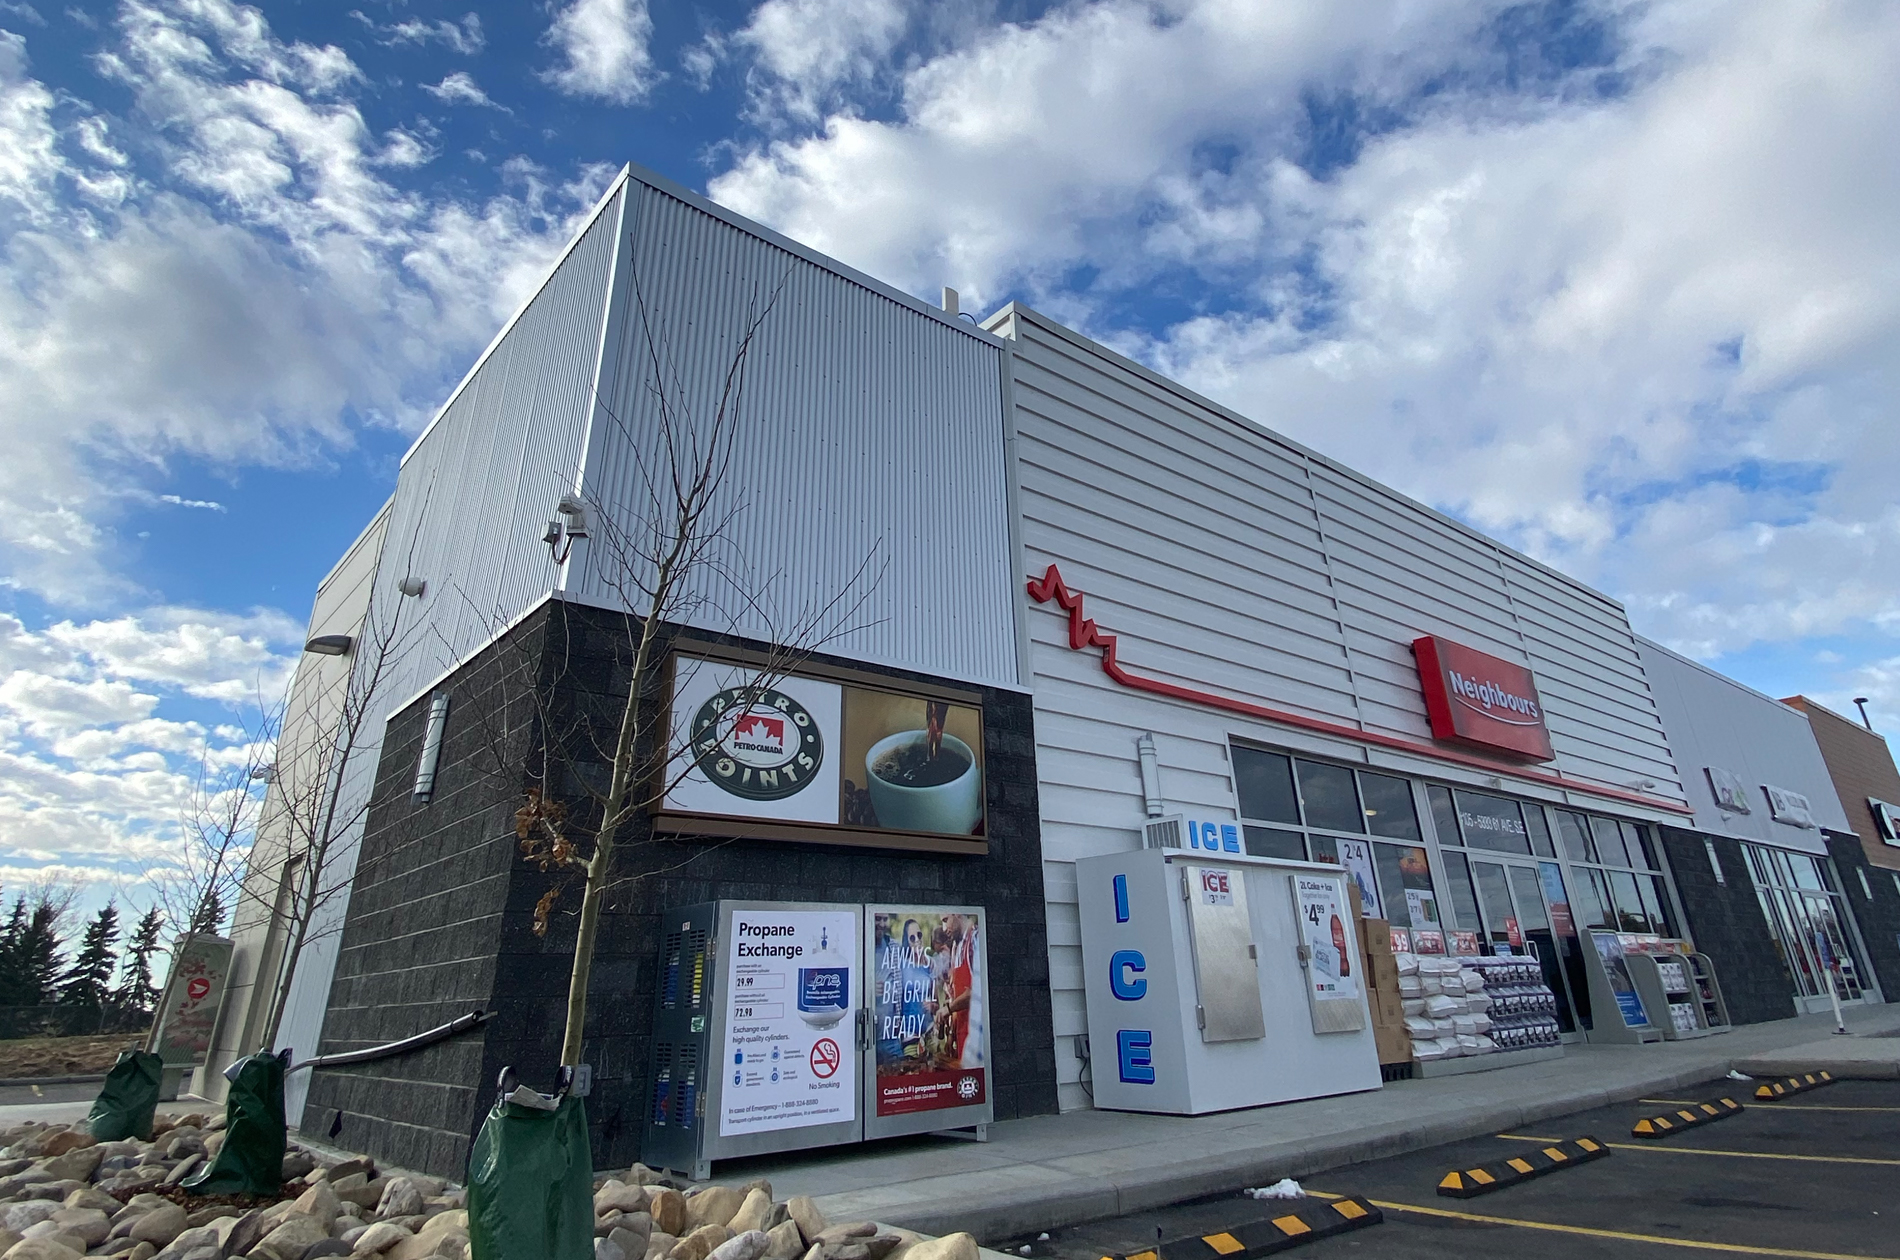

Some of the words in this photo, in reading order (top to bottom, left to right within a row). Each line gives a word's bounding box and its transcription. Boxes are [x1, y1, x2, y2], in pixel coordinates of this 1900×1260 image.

[1449, 670, 1538, 718] Neighbours
[710, 689, 810, 727] PETRO
[699, 738, 814, 789] POINTS
[1188, 820, 1240, 853] ICE
[1201, 870, 1229, 893] ICE
[1307, 881, 1320, 890] Coke
[1325, 883, 1333, 891] Ice
[739, 922, 795, 940] Propane
[738, 942, 803, 959] Exchange
[881, 946, 931, 969] ALWAYS
[736, 977, 754, 987] 29.99
[1109, 874, 1155, 1084] ICE
[882, 980, 899, 1004] BE
[904, 979, 937, 1003] GRILL
[735, 1008, 753, 1017] 72.98
[733, 1026, 760, 1034] Exchange
[882, 1014, 925, 1040] READY
[732, 1036, 745, 1045] high
[745, 1035, 764, 1044] quality
[764, 1034, 790, 1042] cylinders.
[809, 1082, 818, 1090] No
[817, 1081, 840, 1090] Smoking
[883, 1086, 907, 1096] Canada's
[915, 1085, 936, 1093] propane
[751, 1103, 778, 1112] Emergency
